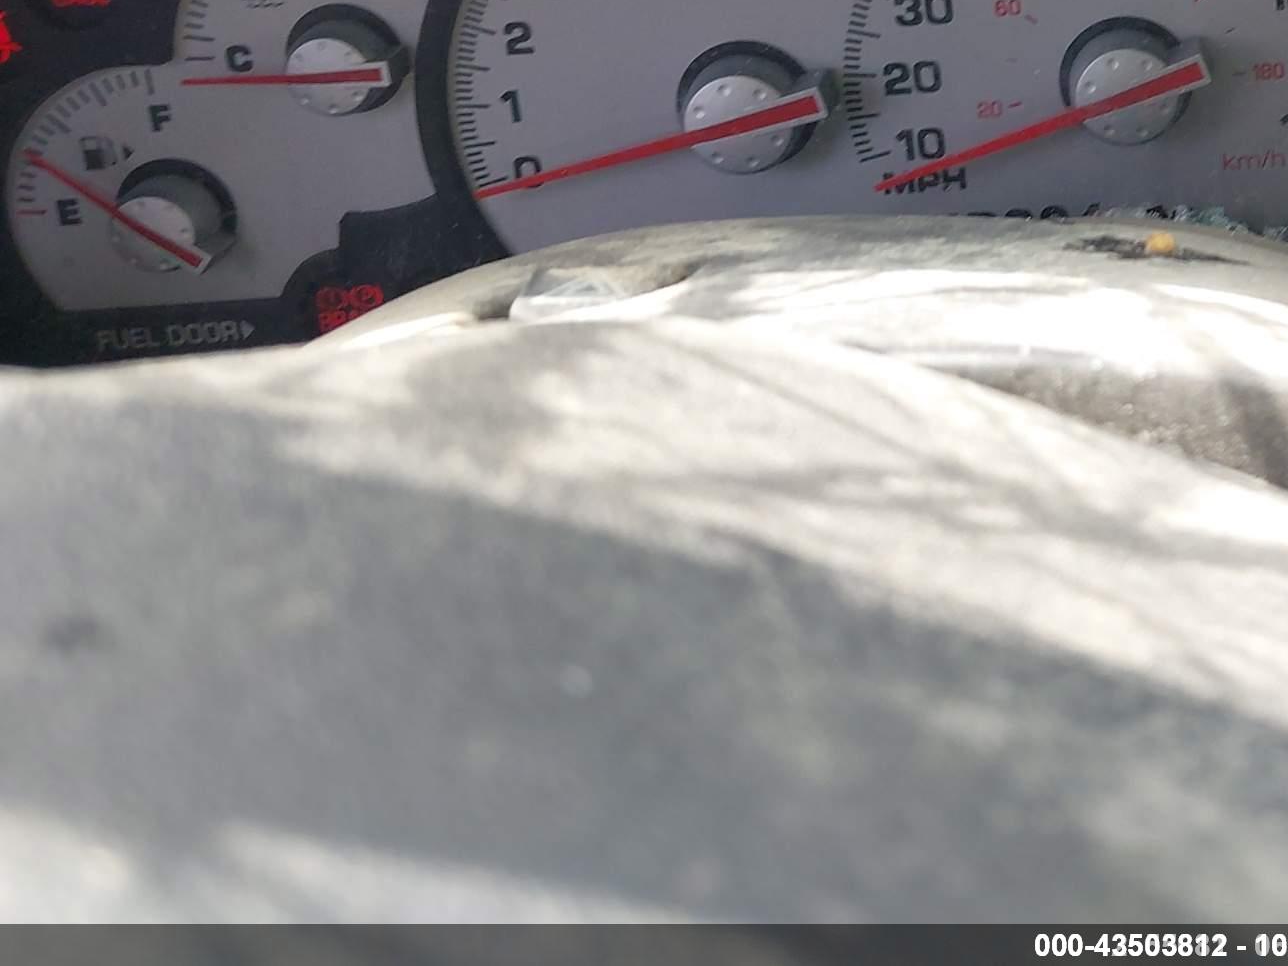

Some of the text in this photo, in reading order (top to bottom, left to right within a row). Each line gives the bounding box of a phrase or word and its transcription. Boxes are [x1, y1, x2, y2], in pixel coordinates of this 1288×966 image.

[504, 21, 535, 56] 2
[225, 44, 254, 74] C
[883, 60, 942, 96] 20
[149, 104, 171, 133] F
[500, 90, 522, 123] 1
[977, 99, 1004, 119] 20
[896, 128, 945, 160] 10
[514, 155, 544, 189] 0
[1221, 151, 1288, 171] km/h
[57, 198, 82, 226] E
[98, 320, 241, 352] FUEL DOOR
